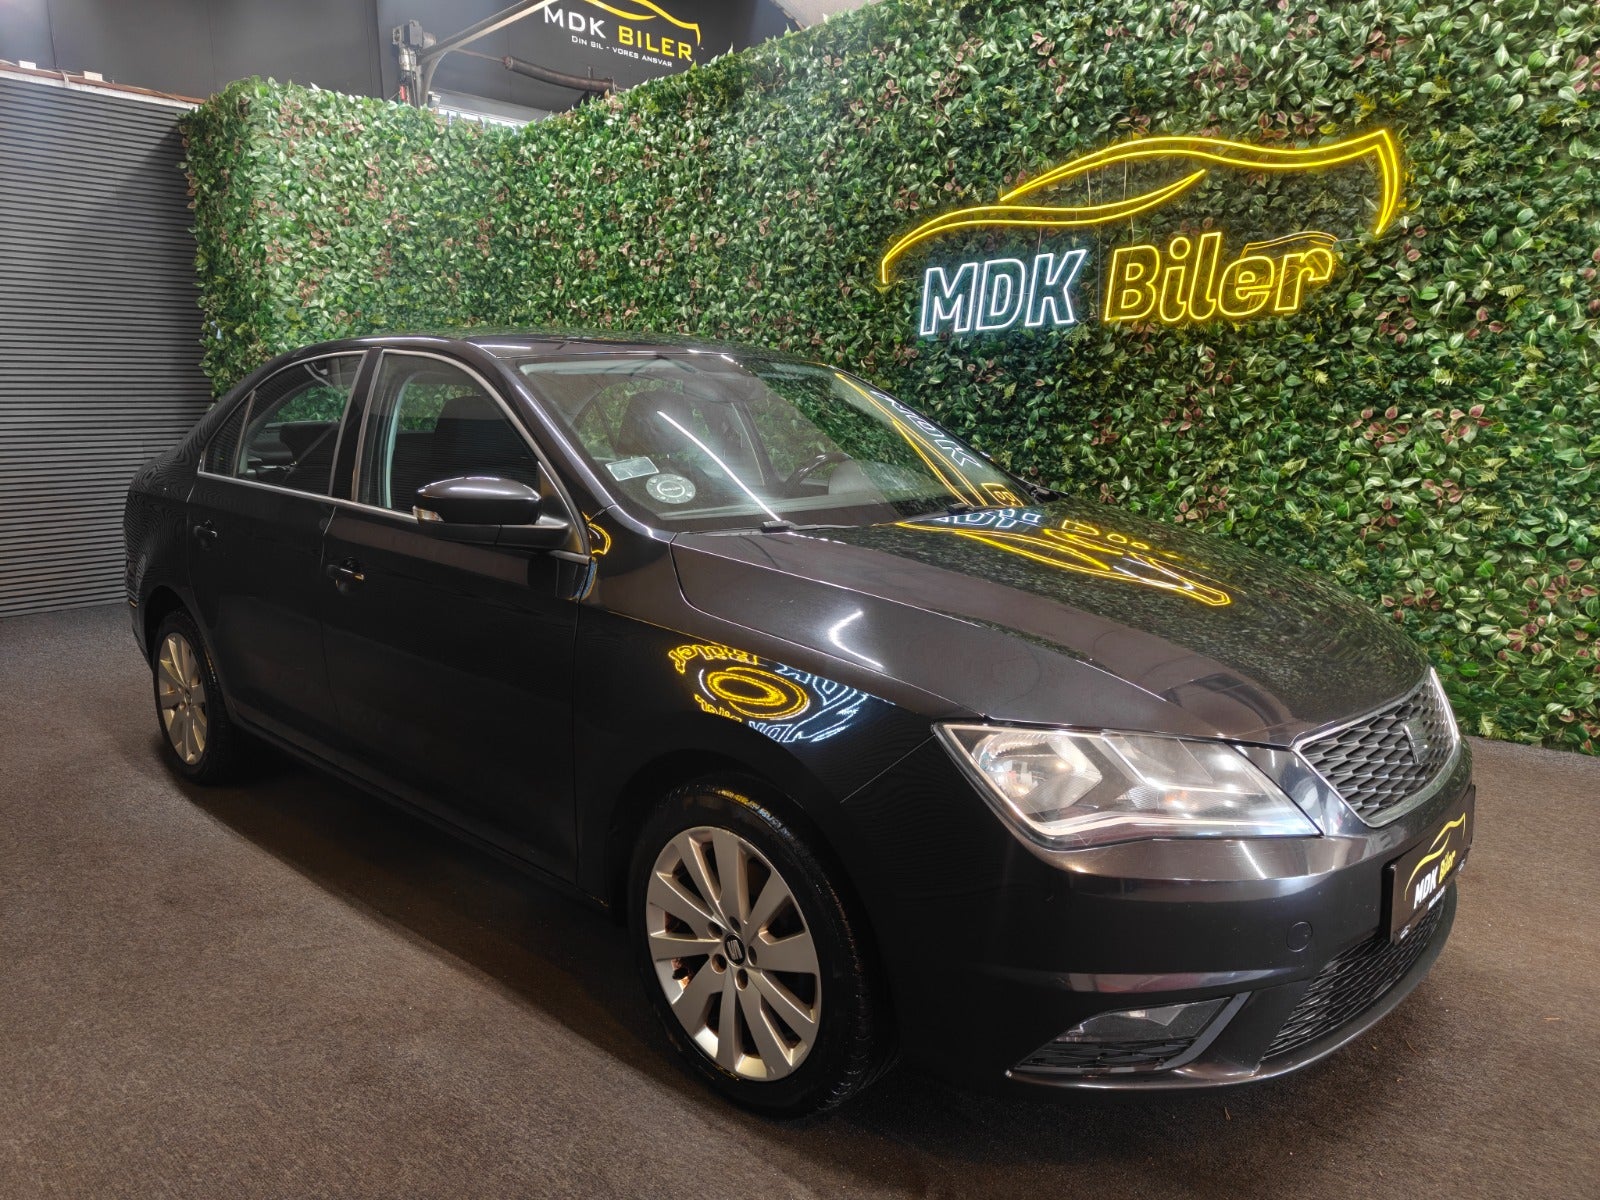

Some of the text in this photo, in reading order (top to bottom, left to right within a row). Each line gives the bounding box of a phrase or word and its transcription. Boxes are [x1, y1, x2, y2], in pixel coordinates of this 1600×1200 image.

[544, 5, 693, 62] MDK BILER
[590, 41, 604, 50] BIL
[612, 47, 639, 59] VORES
[641, 55, 673, 67] ANSVAR
[920, 231, 1336, 336] MDK Biler
[1413, 865, 1439, 910] MDK
